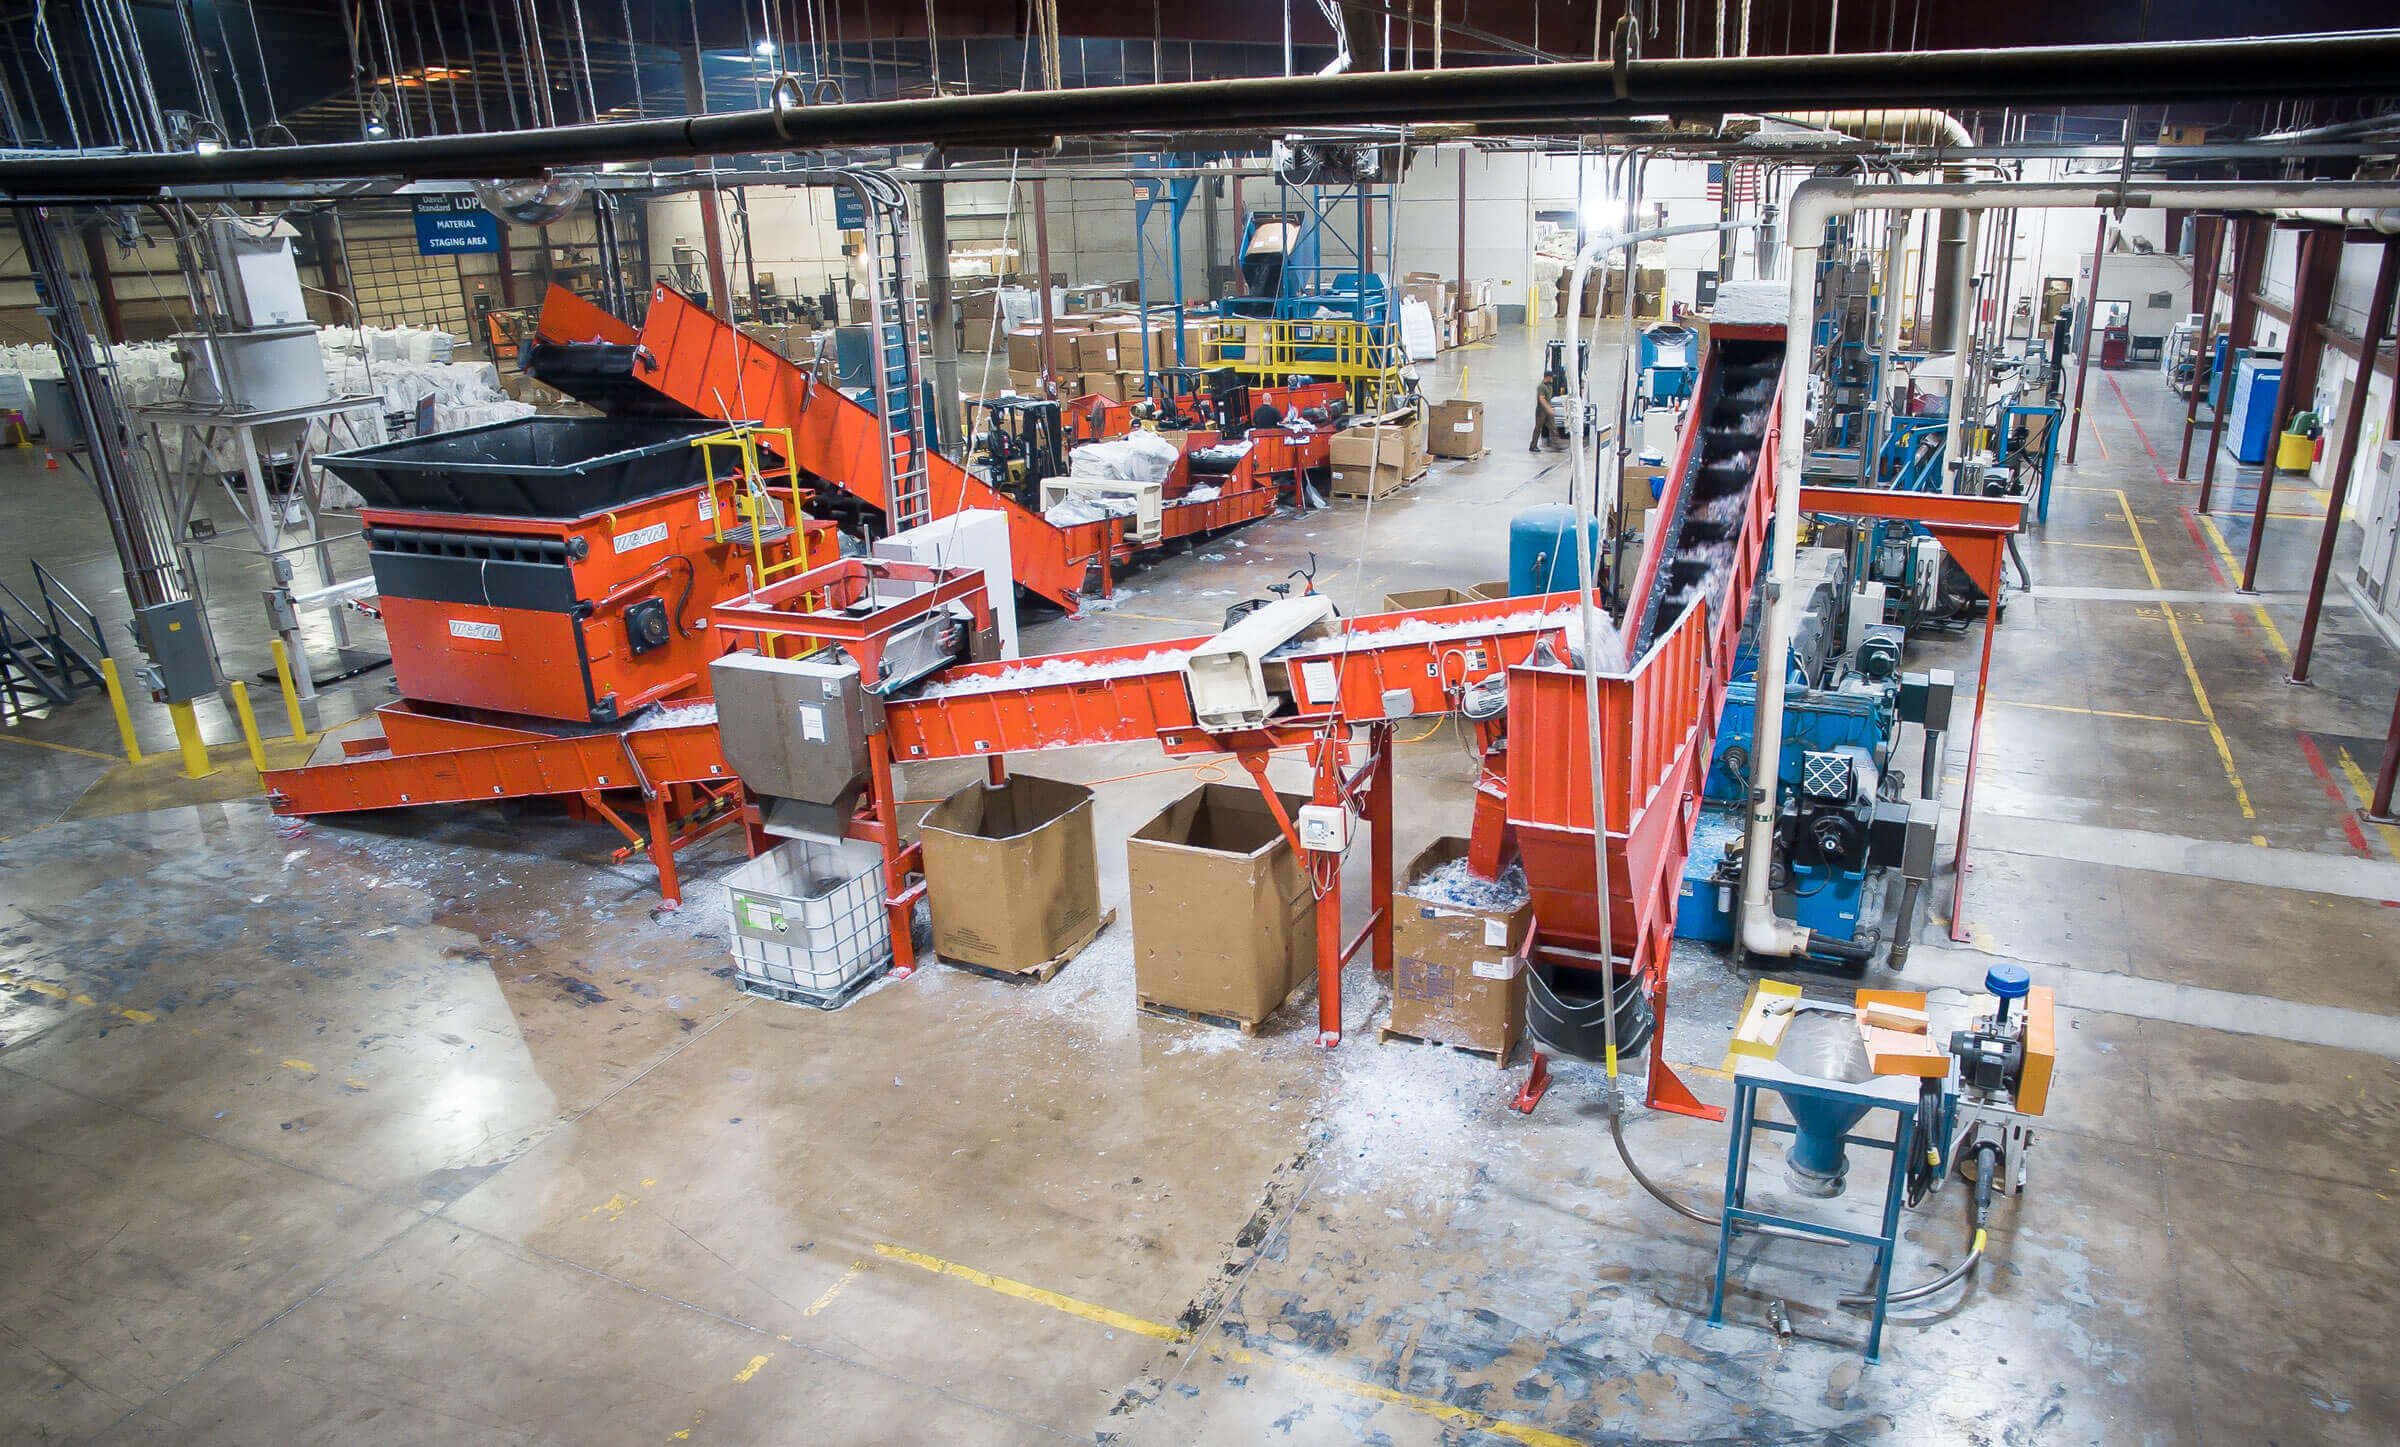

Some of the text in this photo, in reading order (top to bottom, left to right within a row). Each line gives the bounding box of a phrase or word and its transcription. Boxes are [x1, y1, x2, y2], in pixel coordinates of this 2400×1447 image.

[436, 219, 476, 230] MATERIAL
[430, 236, 488, 248] STAGING AREA
[1429, 664, 1437, 676] 5
